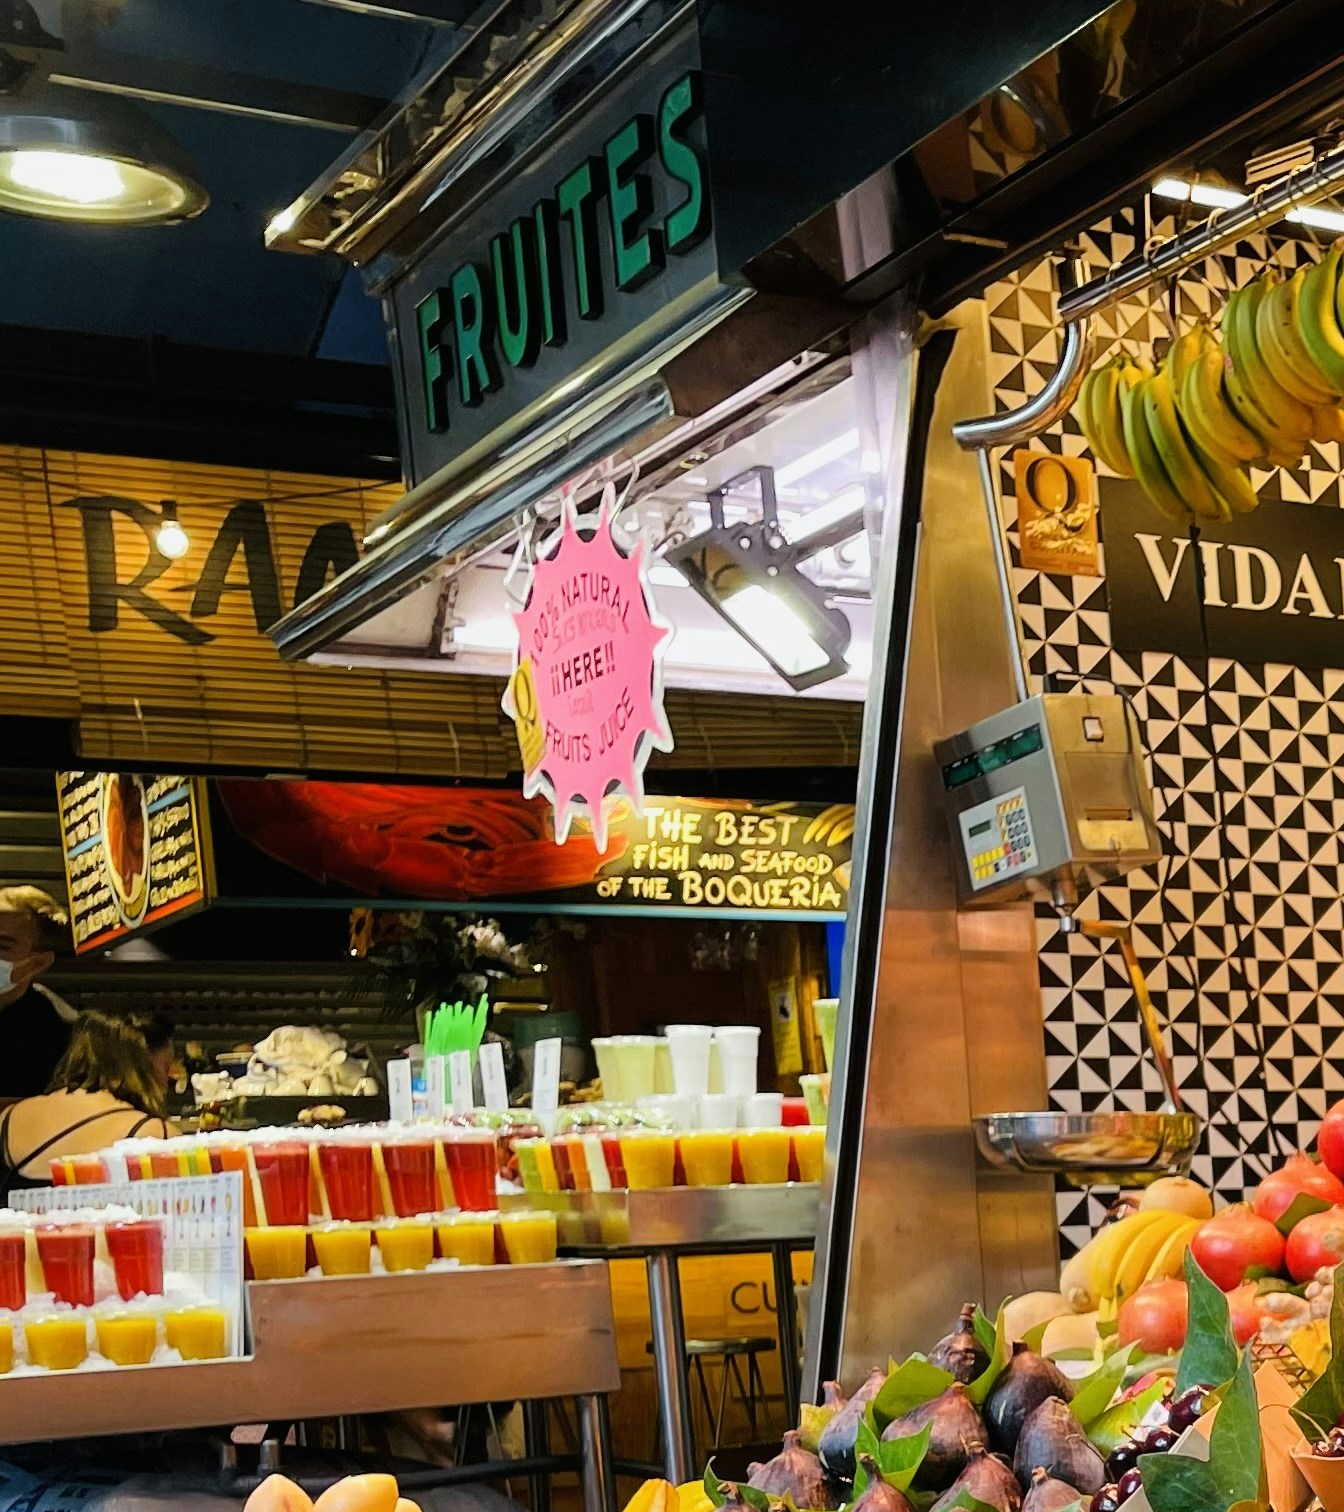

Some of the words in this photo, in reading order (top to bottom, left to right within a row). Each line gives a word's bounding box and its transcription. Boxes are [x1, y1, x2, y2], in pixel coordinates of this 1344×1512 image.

[415, 72, 710, 433] FRUITES
[561, 572, 630, 634] NATURAL
[547, 719, 591, 763] FRUITS
[599, 686, 634, 756] JUICE
[643, 807, 702, 845] THE
[714, 811, 799, 847] BEST
[698, 852, 735, 871] AND
[740, 848, 834, 876] SEAFOOD
[597, 876, 624, 898] OF
[628, 876, 672, 900] THE
